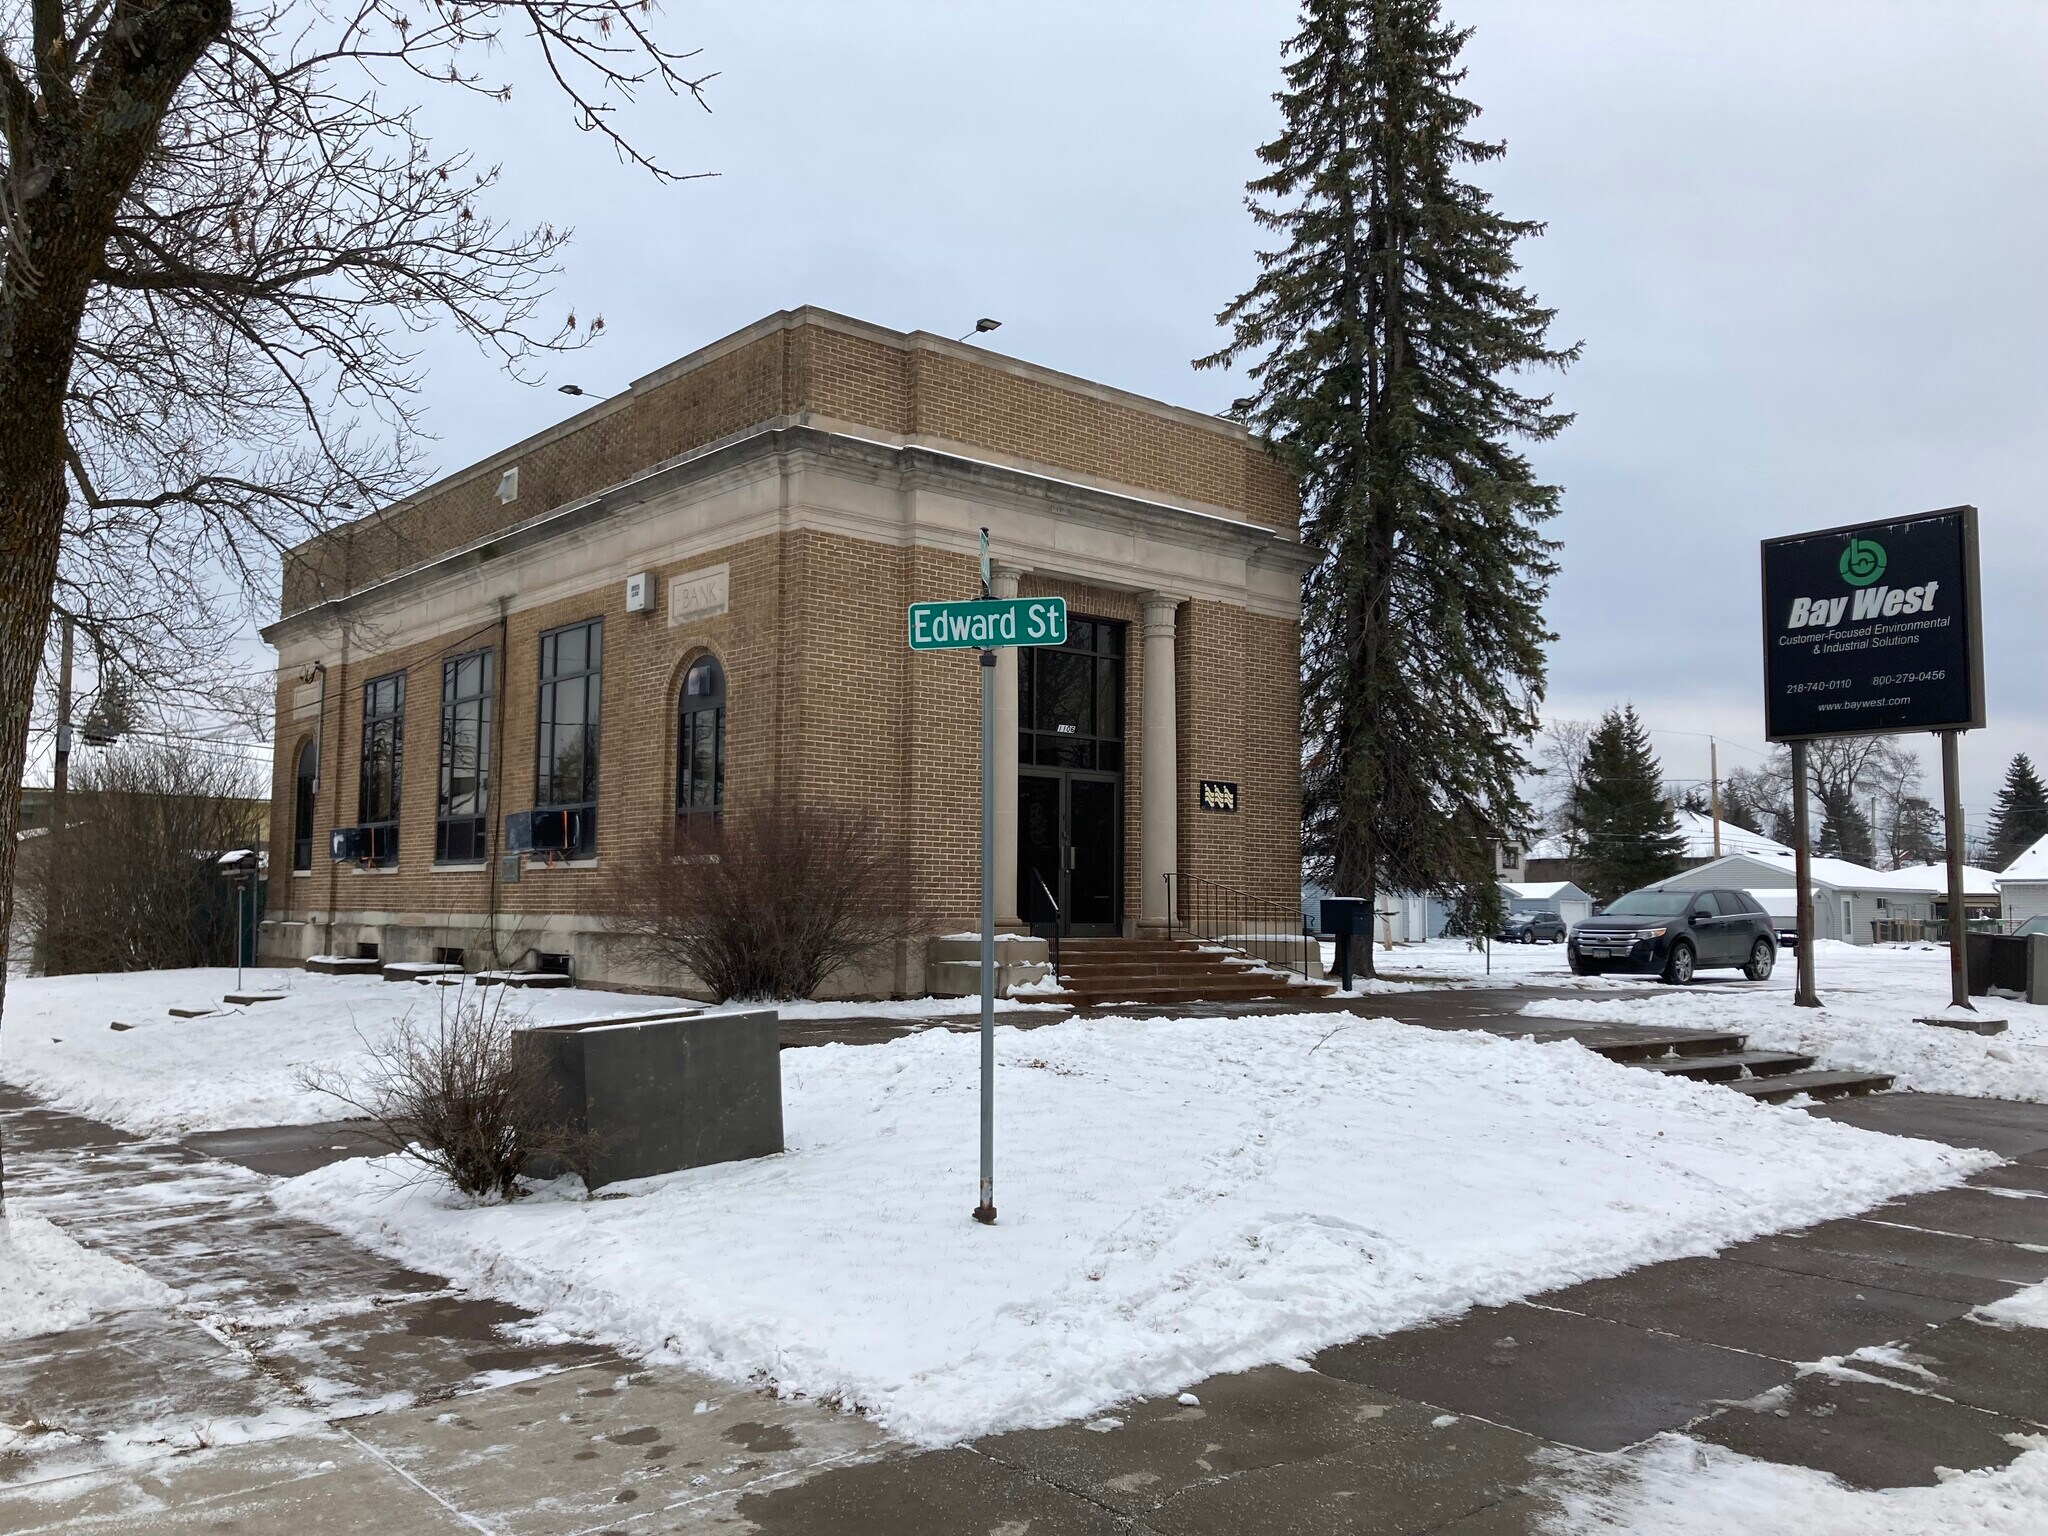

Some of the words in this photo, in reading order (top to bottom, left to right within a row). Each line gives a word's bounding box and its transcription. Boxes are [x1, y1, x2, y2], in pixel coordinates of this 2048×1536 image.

[683, 582, 717, 608] BANK
[1788, 597, 1849, 629] Bay
[1852, 581, 1938, 621] West
[914, 606, 1016, 643] Edward
[1027, 604, 1060, 639] St
[1779, 626, 1872, 646] Customer-Focused
[1874, 616, 1951, 635] Environmental
[1813, 645, 1821, 654] &
[1823, 639, 1869, 654] Industrial
[1872, 634, 1920, 648] Solutions
[1787, 679, 1852, 694] 218-740-0110
[1873, 670, 1946, 686] 800-279-0456
[1818, 697, 1911, 711] www.baywest.com
